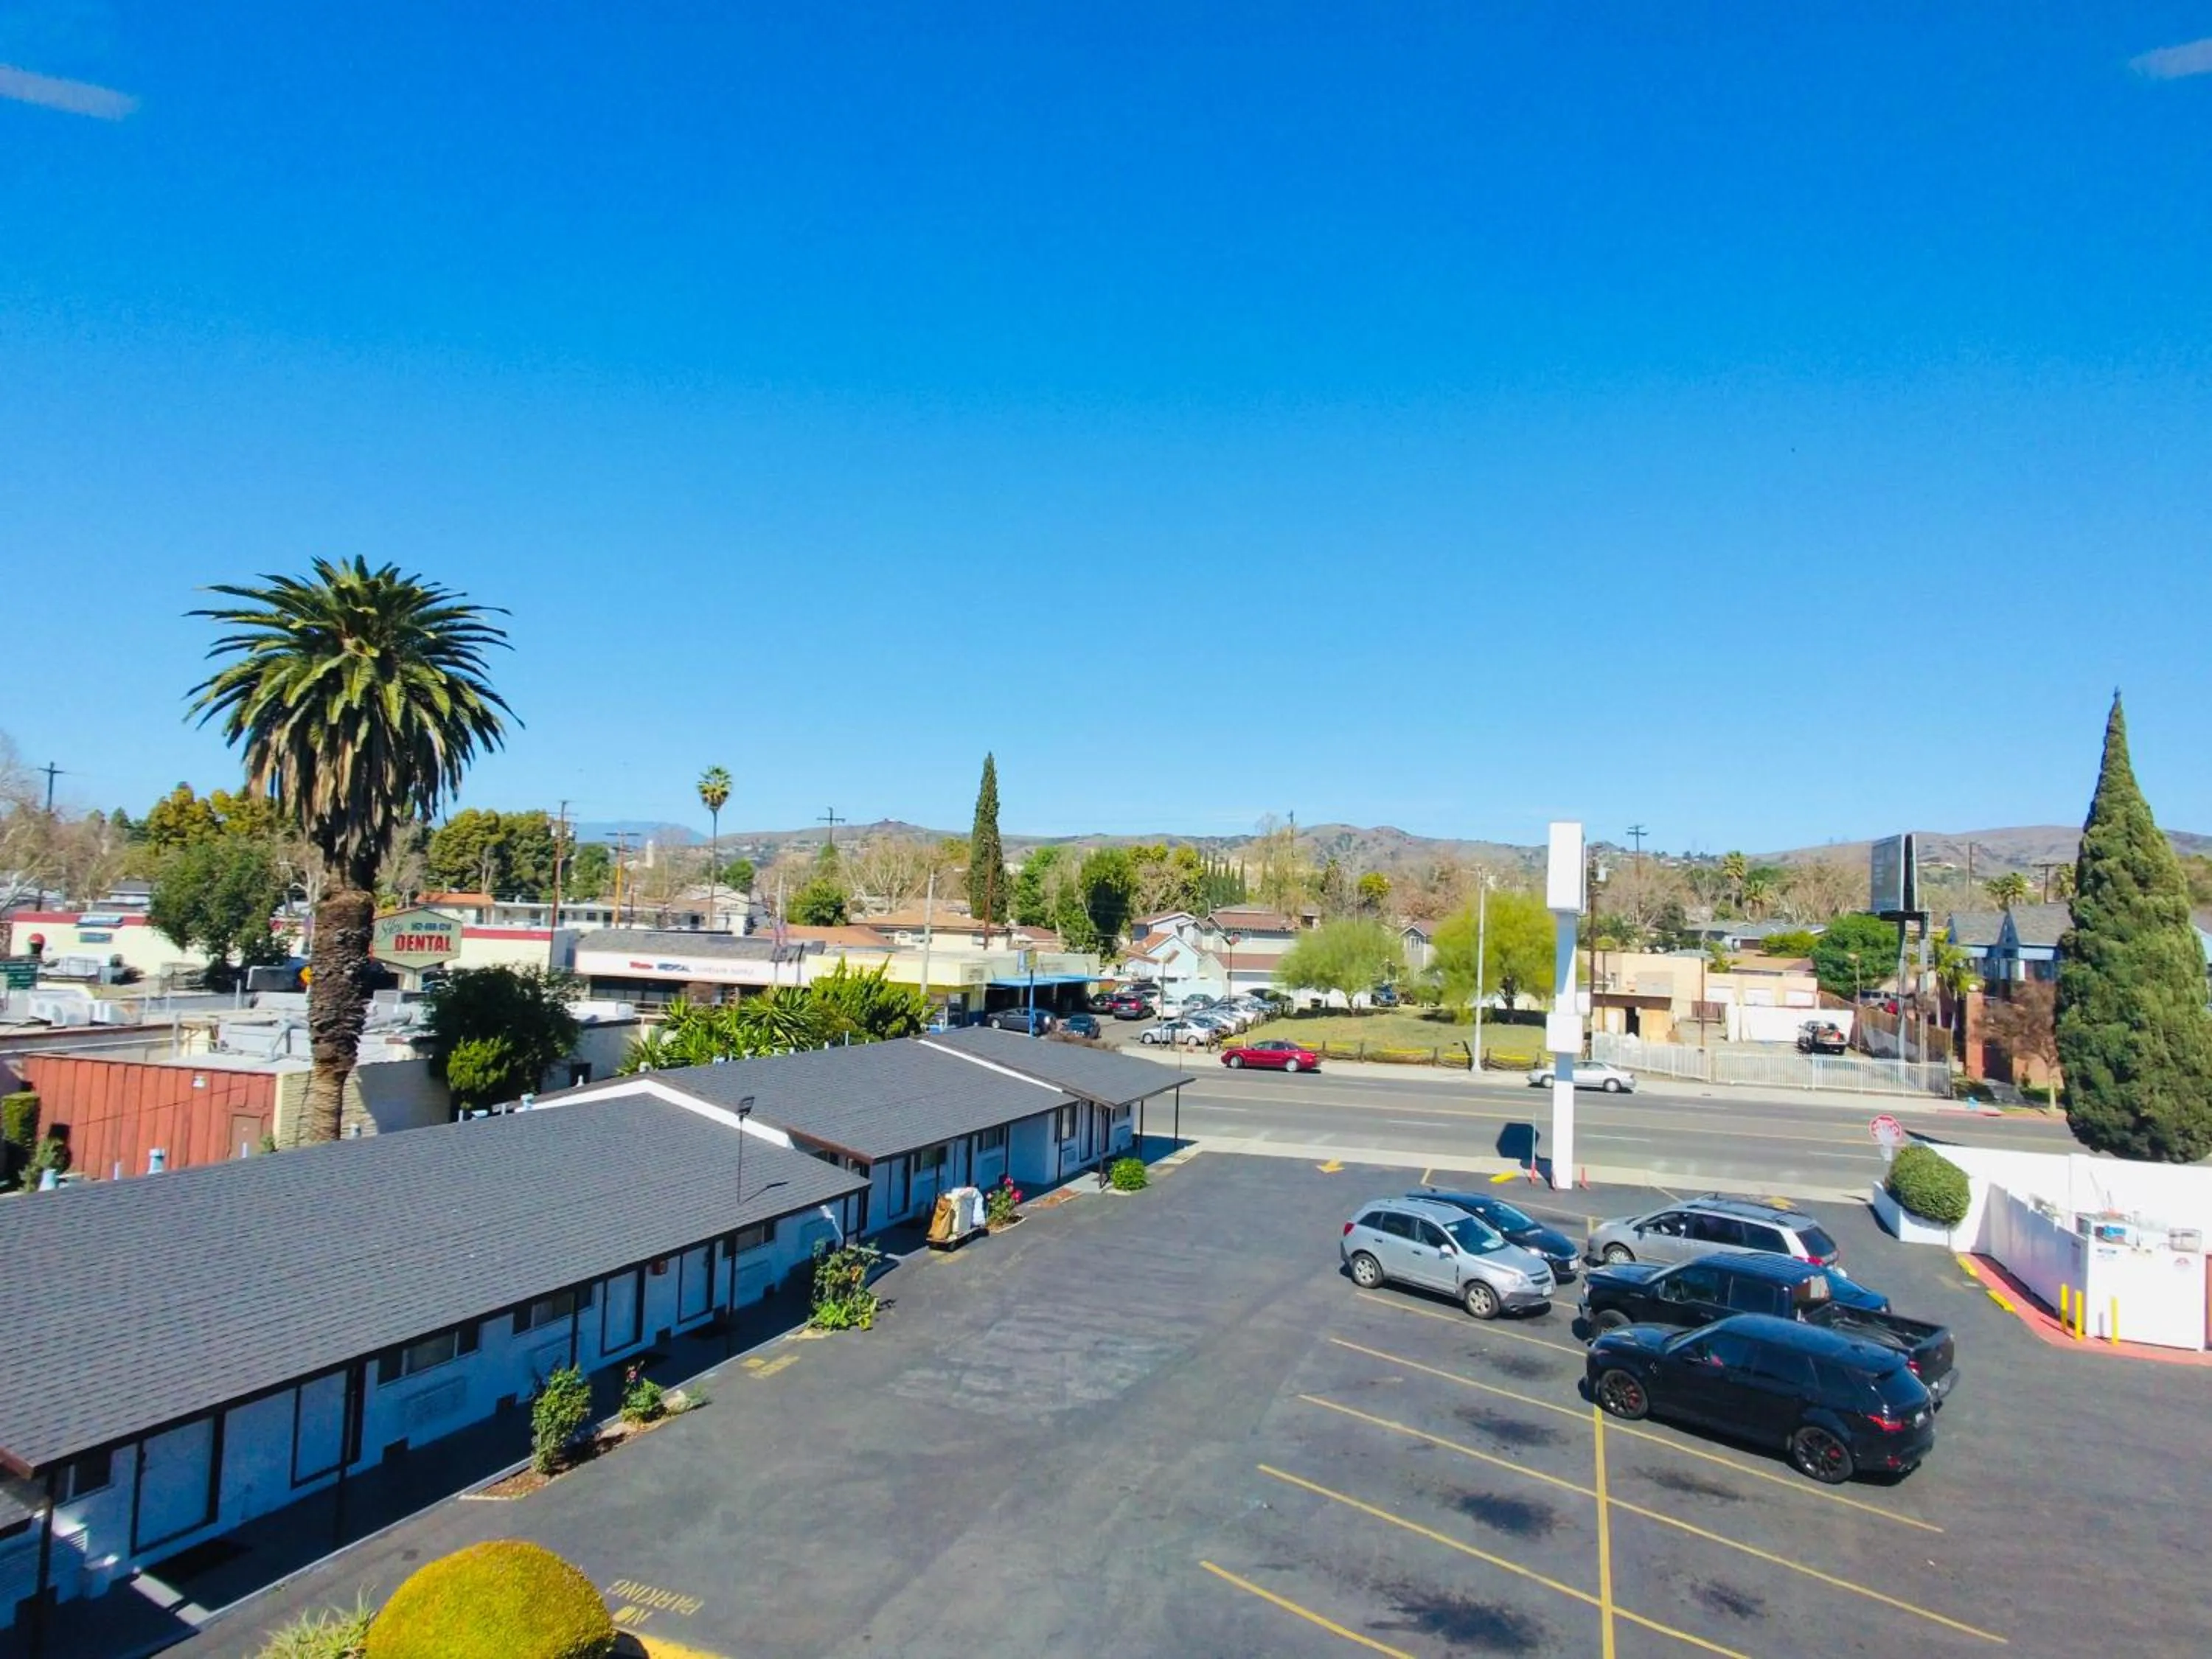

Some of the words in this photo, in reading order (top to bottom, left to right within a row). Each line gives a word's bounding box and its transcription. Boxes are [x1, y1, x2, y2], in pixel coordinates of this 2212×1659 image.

[394, 934, 452, 952] DENTAL
[605, 1579, 705, 1615] PARKING
[613, 1606, 653, 1626] NO
